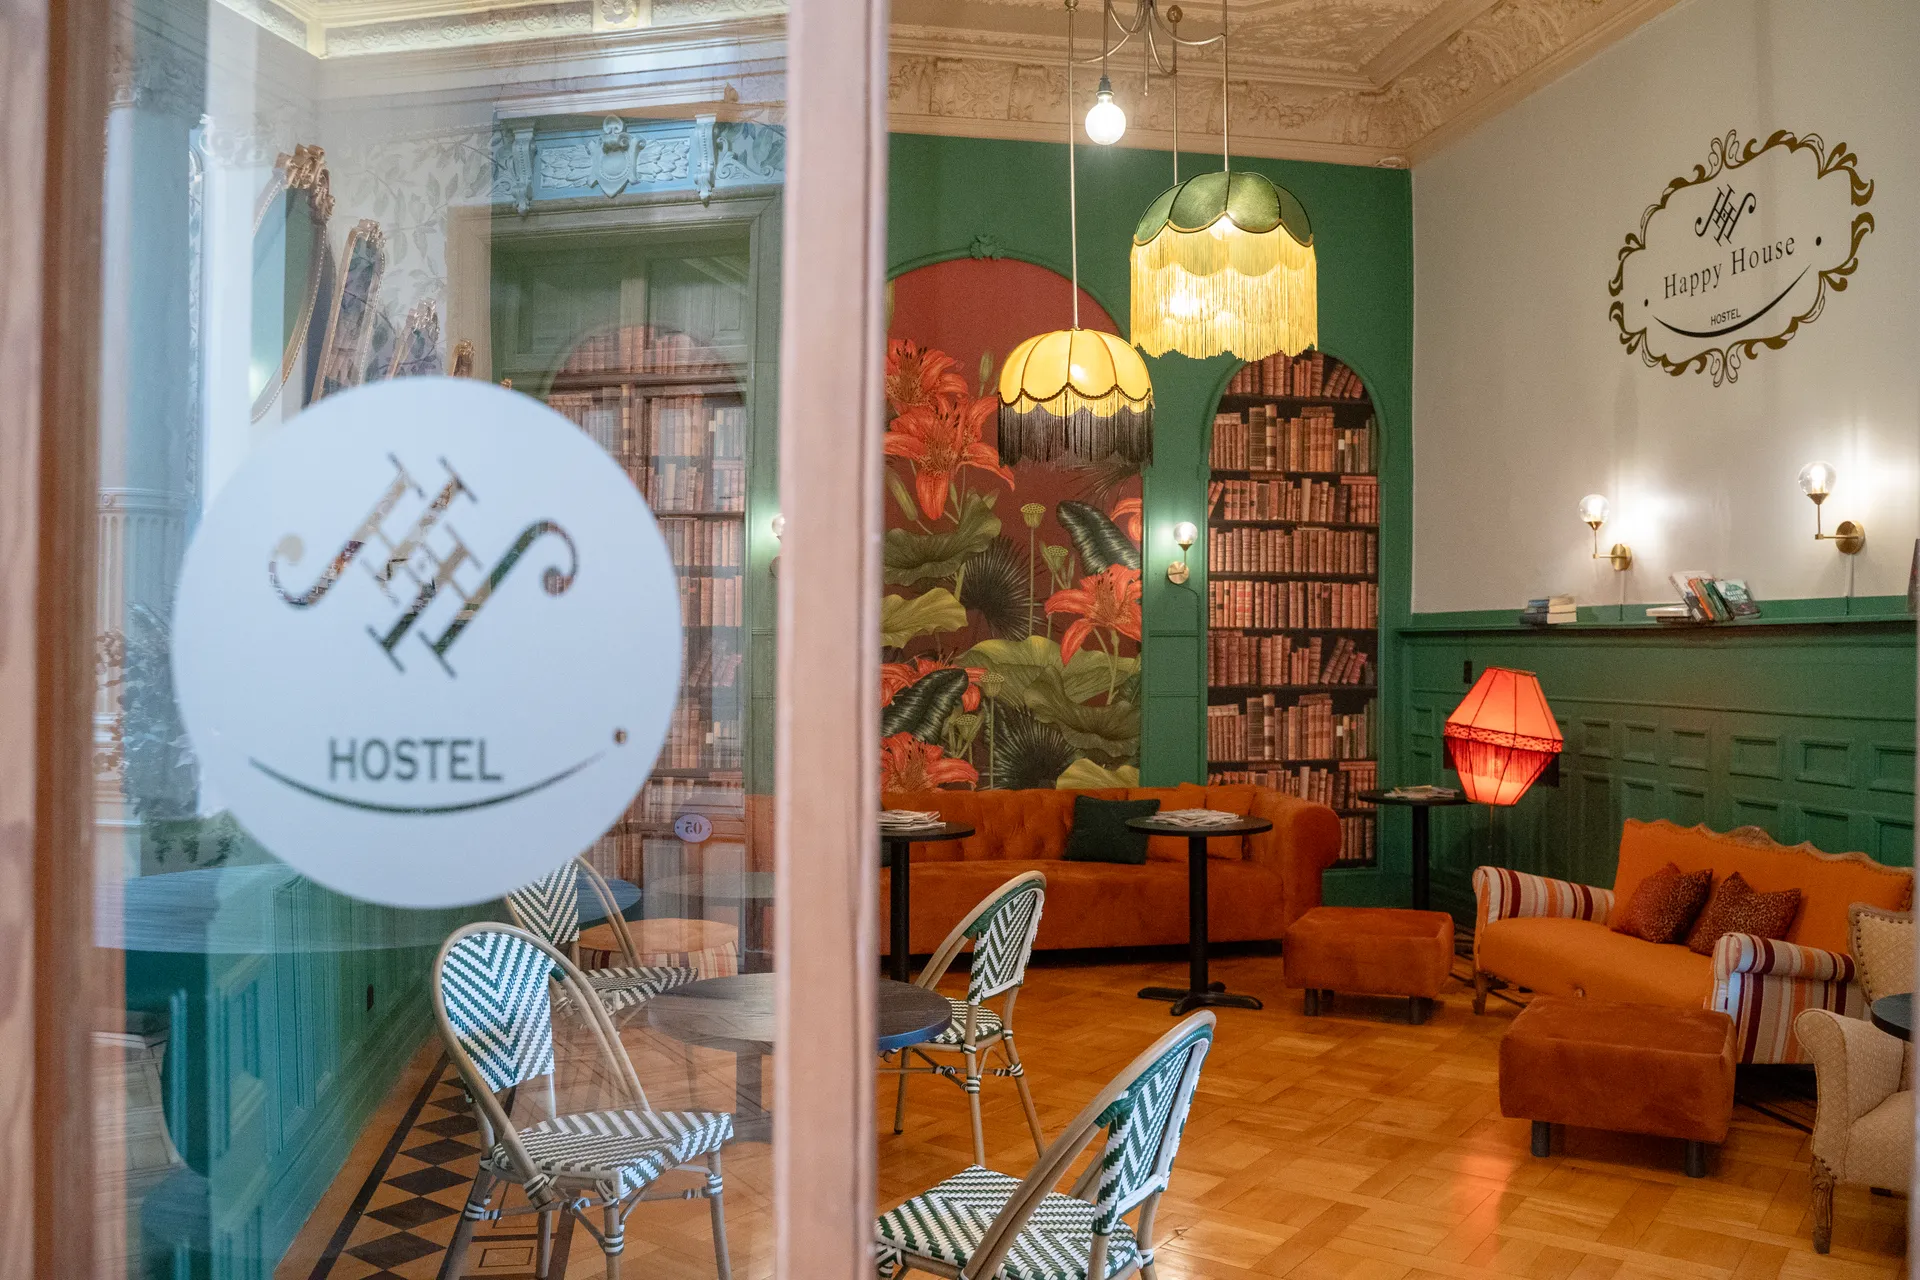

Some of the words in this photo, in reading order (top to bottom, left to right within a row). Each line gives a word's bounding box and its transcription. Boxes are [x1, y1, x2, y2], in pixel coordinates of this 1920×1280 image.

[1664, 263, 1722, 300] Happy
[1731, 237, 1795, 275] House
[1710, 308, 1741, 326] HOSTEL
[328, 737, 504, 783] HOSTEL
